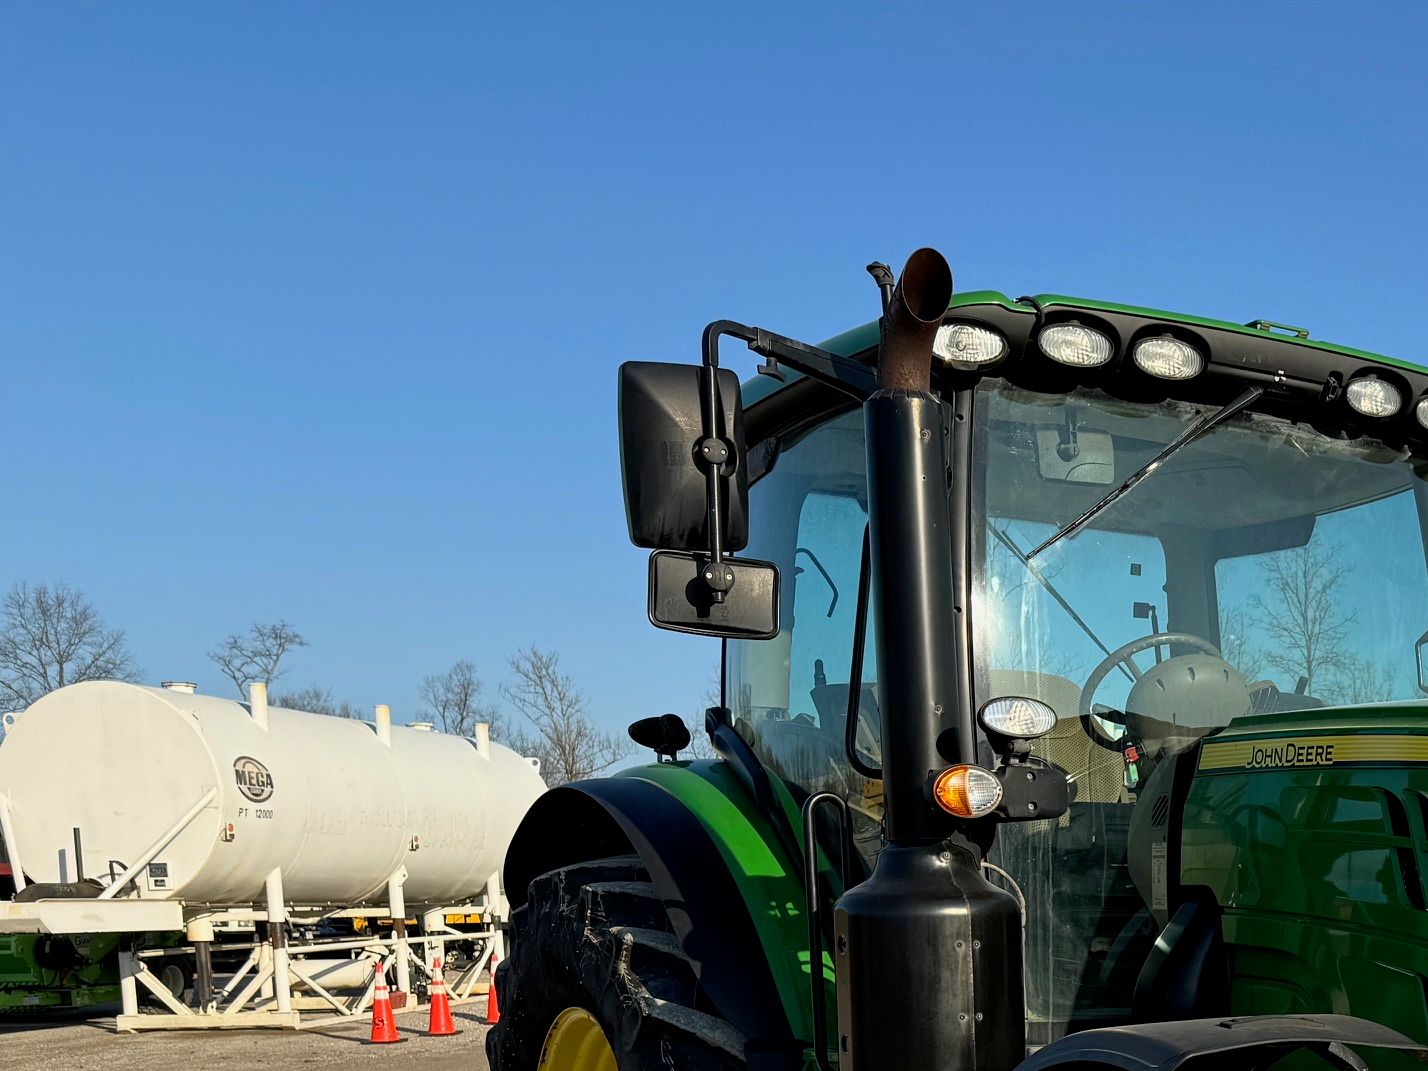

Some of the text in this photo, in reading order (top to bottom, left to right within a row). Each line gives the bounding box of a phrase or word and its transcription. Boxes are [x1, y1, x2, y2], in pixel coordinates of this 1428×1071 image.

[235, 769, 274, 789] MEGA
[238, 807, 274, 819] PT 12000
